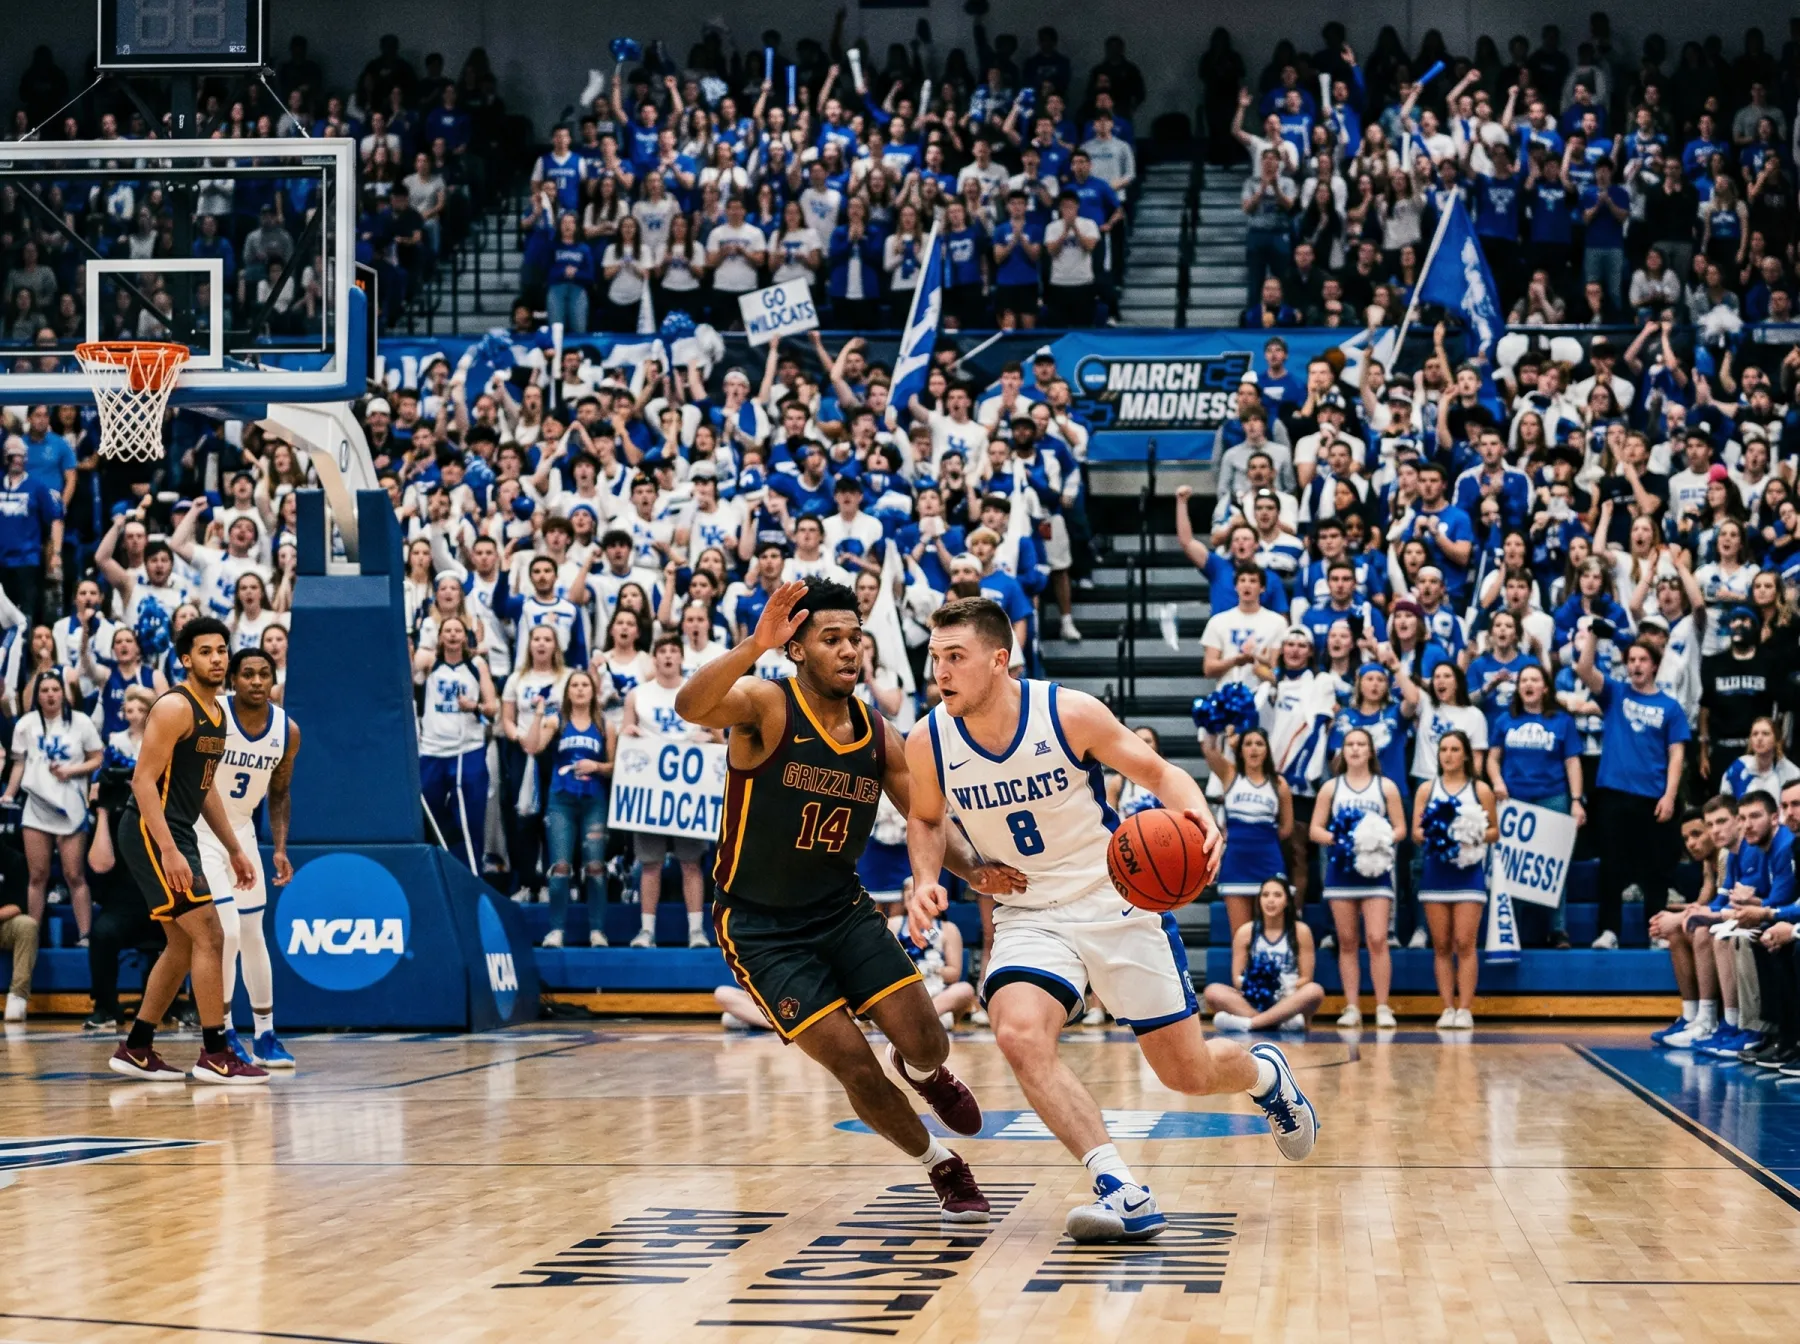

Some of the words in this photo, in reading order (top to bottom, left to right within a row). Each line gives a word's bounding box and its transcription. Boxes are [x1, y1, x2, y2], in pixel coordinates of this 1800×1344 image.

[762, 287, 786, 309] GO
[749, 300, 815, 334] WILDCATS
[1107, 362, 1202, 391] MARCH
[1119, 391, 1239, 421] MADNESS
[654, 707, 687, 732] UK
[37, 735, 72, 762] UK
[222, 749, 280, 771] ILDCATS
[658, 743, 704, 785] GO
[229, 772, 251, 799] 3
[782, 761, 879, 804] GRIZZLIES
[951, 767, 1069, 810] WILDCATS
[796, 801, 852, 852] 14
[1006, 809, 1046, 857] 8
[1499, 806, 1537, 843] GO
[1117, 831, 1143, 876] NCAA
[287, 918, 405, 955] NCAA
[485, 952, 519, 993] NCAA
[491, 1206, 790, 1290] ARENA
[693, 1182, 1037, 1335] UNIVERSITY
